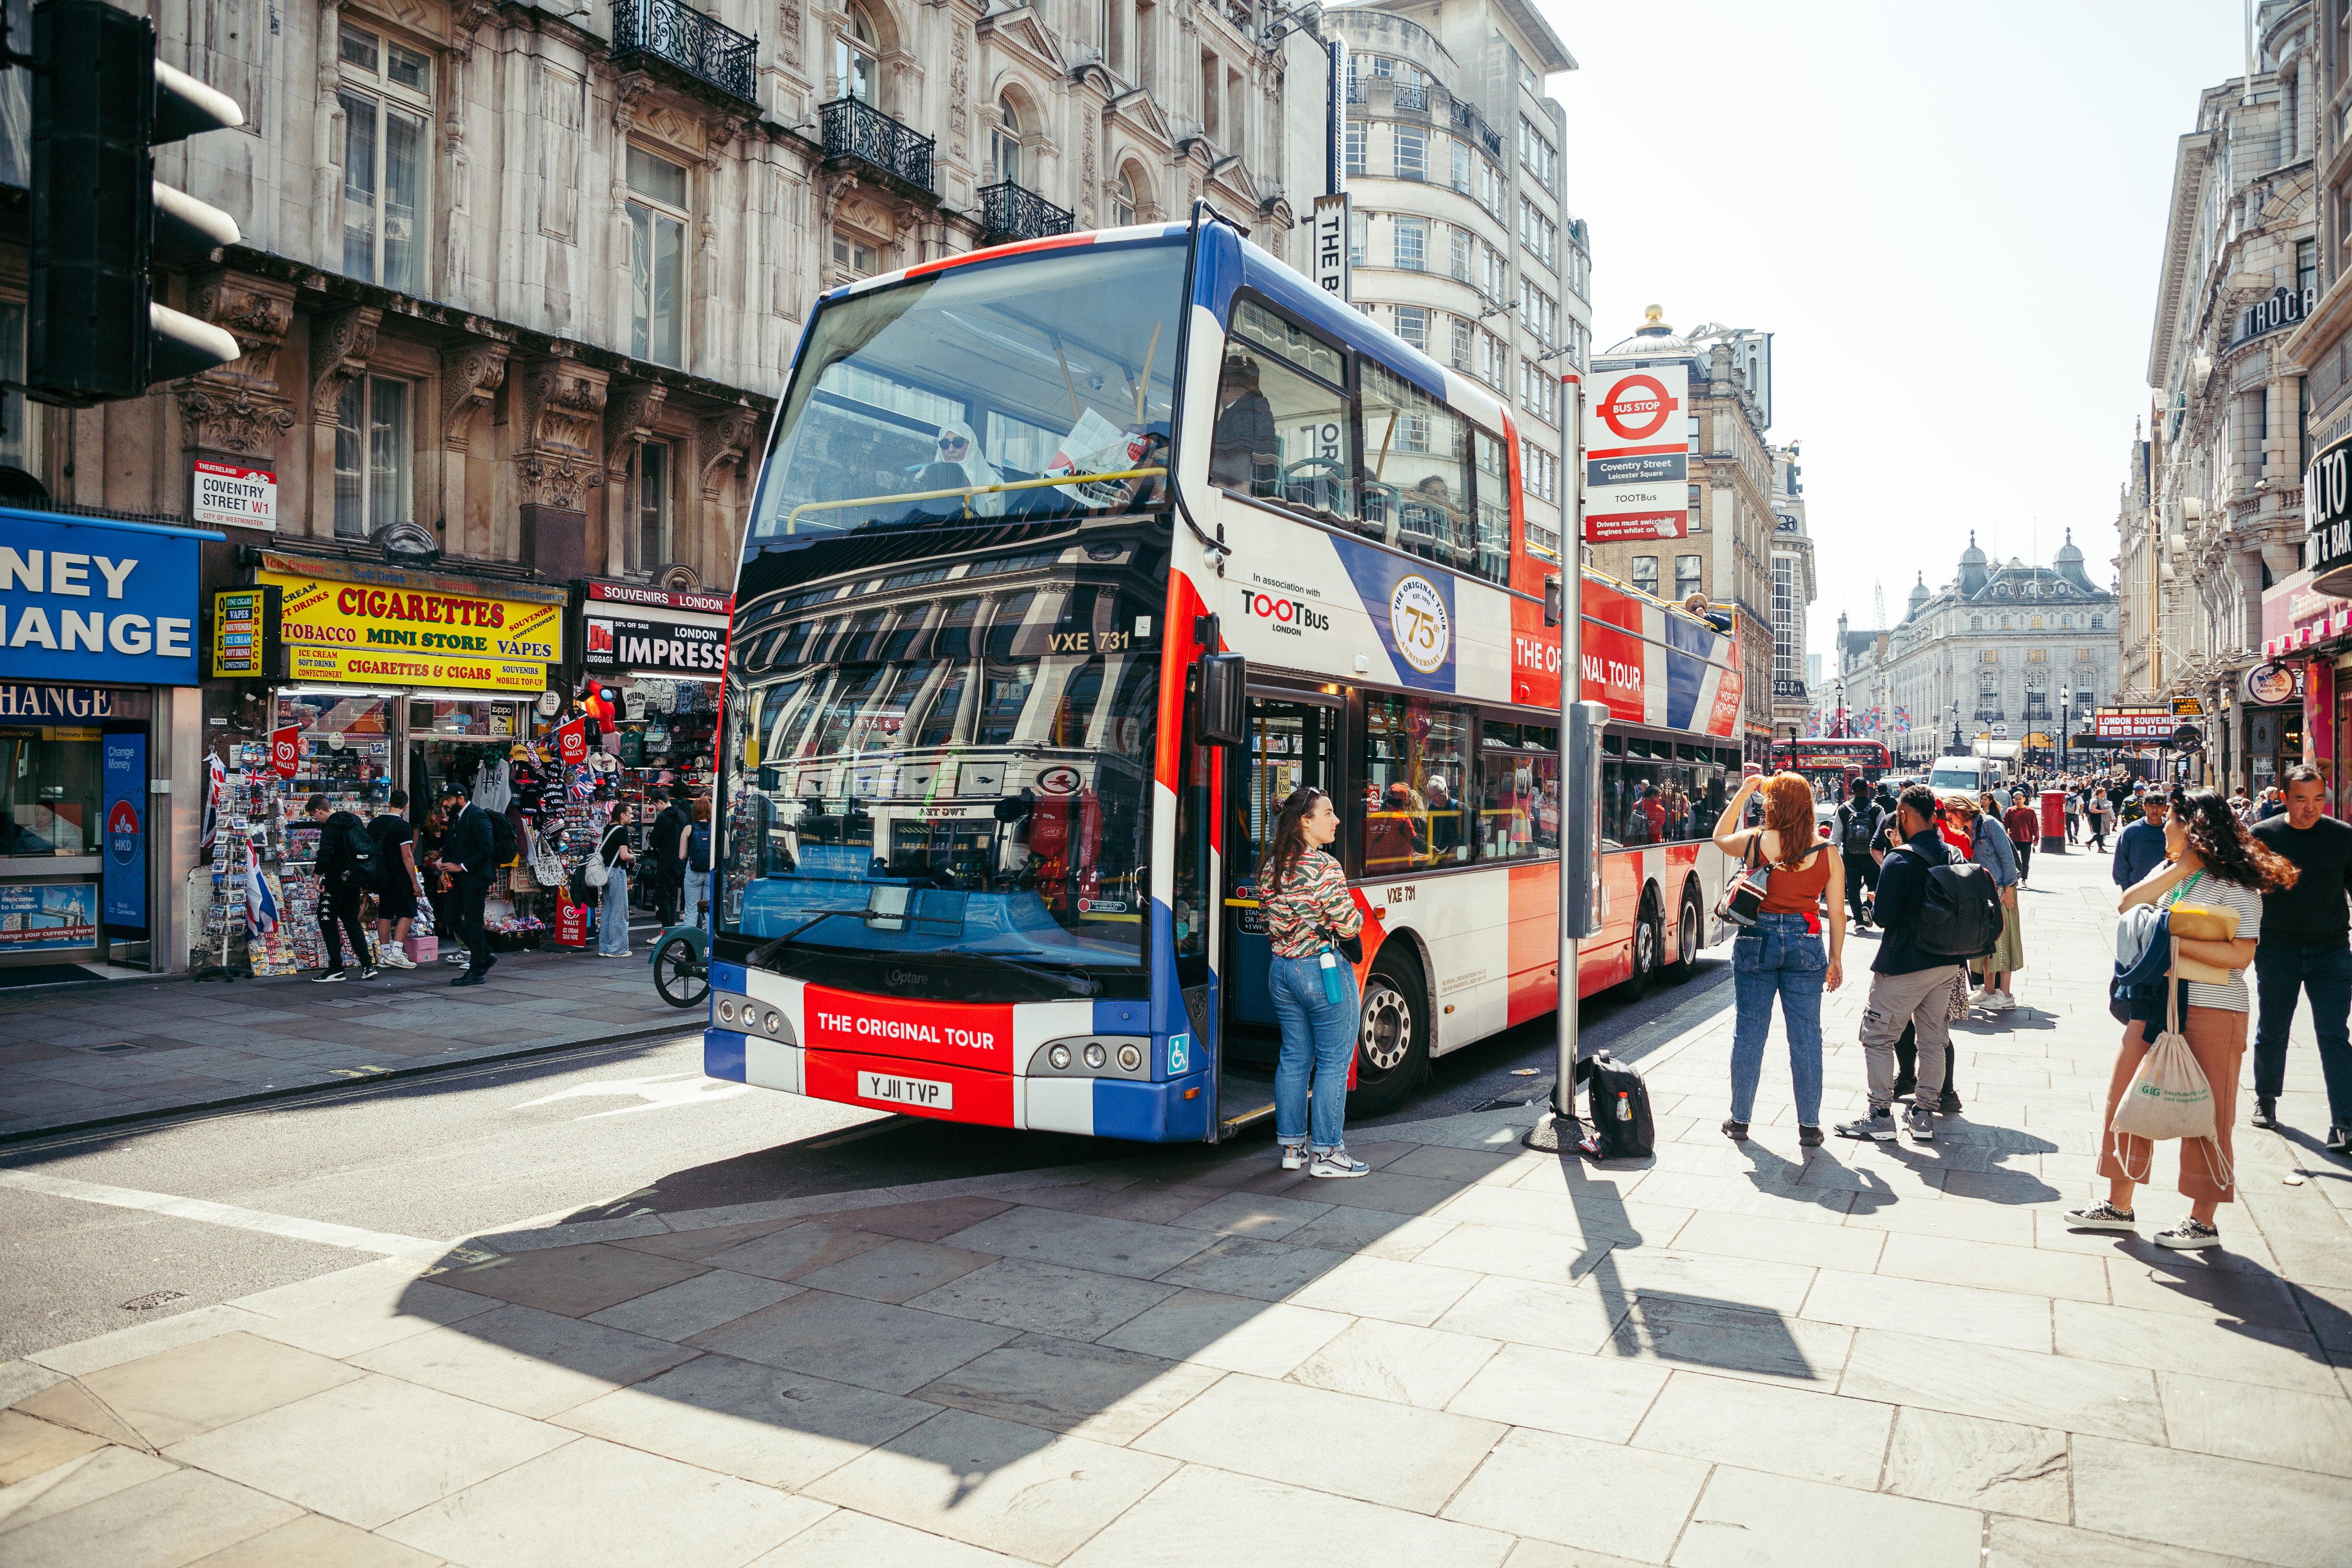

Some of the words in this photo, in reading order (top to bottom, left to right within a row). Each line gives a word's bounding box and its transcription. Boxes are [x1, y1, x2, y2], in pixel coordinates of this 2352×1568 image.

[1322, 216, 1339, 269] THE
[1613, 403, 1632, 413] BUS
[1634, 401, 1660, 411] STOP
[199, 463, 236, 475] THEATRELAND
[1600, 462, 1641, 473] Coventry
[1643, 459, 1671, 468] Street
[1640, 470, 1663, 479] Square
[203, 478, 264, 499] COVENTRY
[203, 493, 247, 511] STREET
[252, 501, 268, 514] W1
[225, 516, 263, 526] WESTMINSTER
[2332, 520, 2351, 558] BAR
[266, 556, 283, 568] Ice
[288, 559, 323, 573] Cream
[354, 568, 374, 580] Soft
[377, 571, 406, 583] Drink
[434, 578, 480, 592] Souvenirs
[505, 586, 564, 604] Confectionery
[1253, 573, 1260, 582] In
[1263, 575, 1304, 594] association
[1306, 588, 1320, 597] with
[282, 582, 318, 604] CREAM
[604, 586, 668, 604] SOUVENIRS
[679, 595, 723, 610] LONDON
[1422, 596, 1431, 606] 1951
[294, 591, 329, 614] DRINKS
[338, 587, 505, 629] CIGARETTES
[1394, 591, 1404, 611] THE
[1403, 581, 1435, 601] ORIGINAL
[1436, 601, 1446, 630] TOUR
[230, 610, 249, 619] VAPES
[509, 605, 553, 632] SOUVENIRS
[0, 604, 191, 657] ANGE
[216, 597, 225, 671] OPEN
[225, 623, 252, 631] SOUVENIRS
[252, 594, 261, 671] TOBACCO
[513, 614, 557, 640] CONFECTIONERY
[675, 627, 717, 640] LONDON
[1273, 624, 1301, 636] LONDON
[225, 636, 234, 644] ICE
[235, 635, 251, 643] CREAM
[282, 623, 356, 643] TOBACCO
[366, 628, 417, 645] MINI
[421, 632, 488, 651] STORE
[497, 640, 551, 658] VAPES
[1048, 632, 1089, 651] VXE
[1099, 631, 1129, 650] 731
[226, 648, 235, 656] SOFT
[236, 648, 250, 656] DRINKS
[313, 650, 338, 659] CREAM
[587, 655, 613, 663] LUGGAGE
[620, 636, 727, 670] IMPRESS
[1401, 641, 1440, 666] ANNIVERSARY
[348, 660, 429, 676] CIGARETTES
[433, 665, 443, 677] &
[447, 666, 491, 679] CIGARS
[502, 666, 538, 675] SOUVENIRS
[1516, 637, 1542, 670] THE
[1546, 645, 1606, 684] ORNAL
[1609, 661, 1641, 691] TOUR
[298, 669, 342, 678] CONFECTIONERY
[1721, 690, 1738, 705] HOP-ON
[1716, 701, 1736, 716] HOP-OFF
[2099, 717, 2131, 725] LONDON
[109, 746, 134, 758] Change
[108, 759, 131, 771] Money
[276, 760, 294, 770] WALL'S
[114, 839, 131, 851] HKD
[1387, 888, 1403, 904] VXE
[1405, 885, 1415, 901] 731
[43, 929, 74, 937] currency
[892, 969, 928, 985] Optare
[817, 1012, 851, 1032] THE
[856, 1018, 940, 1043] ORIGINAL
[944, 1028, 994, 1050] TOUR
[871, 1076, 900, 1099] YJ11
[906, 1081, 939, 1103] TVP
